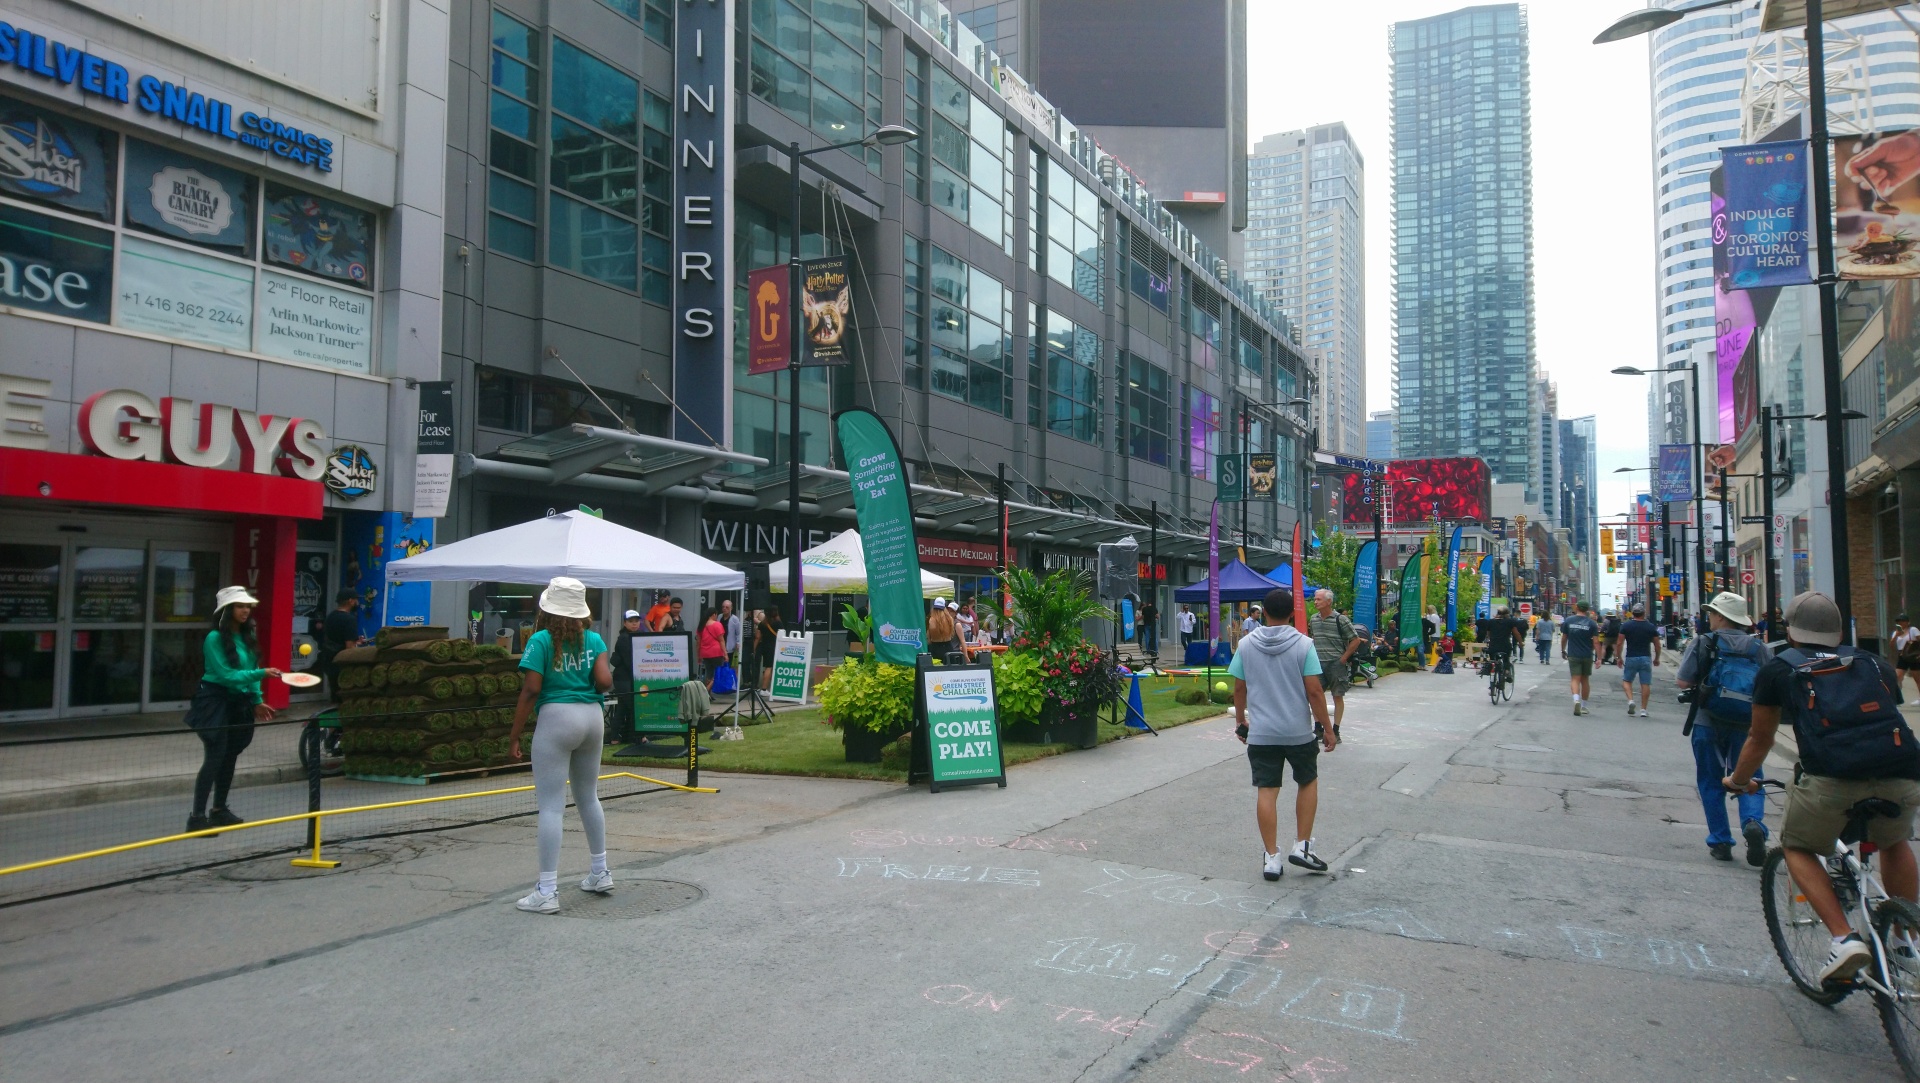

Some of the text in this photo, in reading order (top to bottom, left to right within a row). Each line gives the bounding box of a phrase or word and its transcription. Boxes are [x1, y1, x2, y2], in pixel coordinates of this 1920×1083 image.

[0, 20, 238, 140] SILVER SNAIL
[241, 132, 270, 151] and
[242, 111, 333, 155] COMICS
[680, 0, 715, 338] INNERS
[187, 176, 200, 186] THE
[172, 181, 211, 205] BLACK
[168, 194, 216, 220] CANARY
[1730, 207, 1795, 221] INDULGE
[1758, 221, 1774, 231] IN
[1730, 231, 1809, 245] TORONTO'S
[1727, 244, 1797, 257] CULTURAL
[828, 261, 842, 269] STAGE
[1756, 255, 1801, 267] HEART
[806, 272, 845, 290] Harry Potter
[267, 281, 365, 315] 2nd Floor Retail
[122, 292, 139, 305] +1
[145, 296, 171, 312] 416
[176, 302, 204, 318] 362
[209, 309, 245, 327] 2244
[268, 306, 299, 323] Arlin
[268, 322, 314, 343] Jackson
[419, 409, 437, 423] For
[79, 388, 327, 482] GUYS
[419, 423, 451, 437] Lease
[328, 447, 374, 479] Silver
[860, 452, 886, 468] Grow
[327, 466, 375, 491] Snail
[854, 460, 896, 481] Something
[857, 472, 896, 491] You Can
[1363, 459, 1371, 504] Yonge
[870, 486, 887, 499] Eat
[918, 544, 959, 558] CHIPOTLE
[960, 548, 993, 561] MEXICAN
[1671, 574, 1680, 583] H
[777, 666, 803, 677] COME
[776, 677, 801, 688] PLAY!
[942, 688, 987, 696] CHALLENGE
[934, 720, 992, 738] COME
[938, 741, 992, 760] PLAY!
[835, 857, 1042, 887] FREE
[923, 983, 1159, 1037] ON THE
